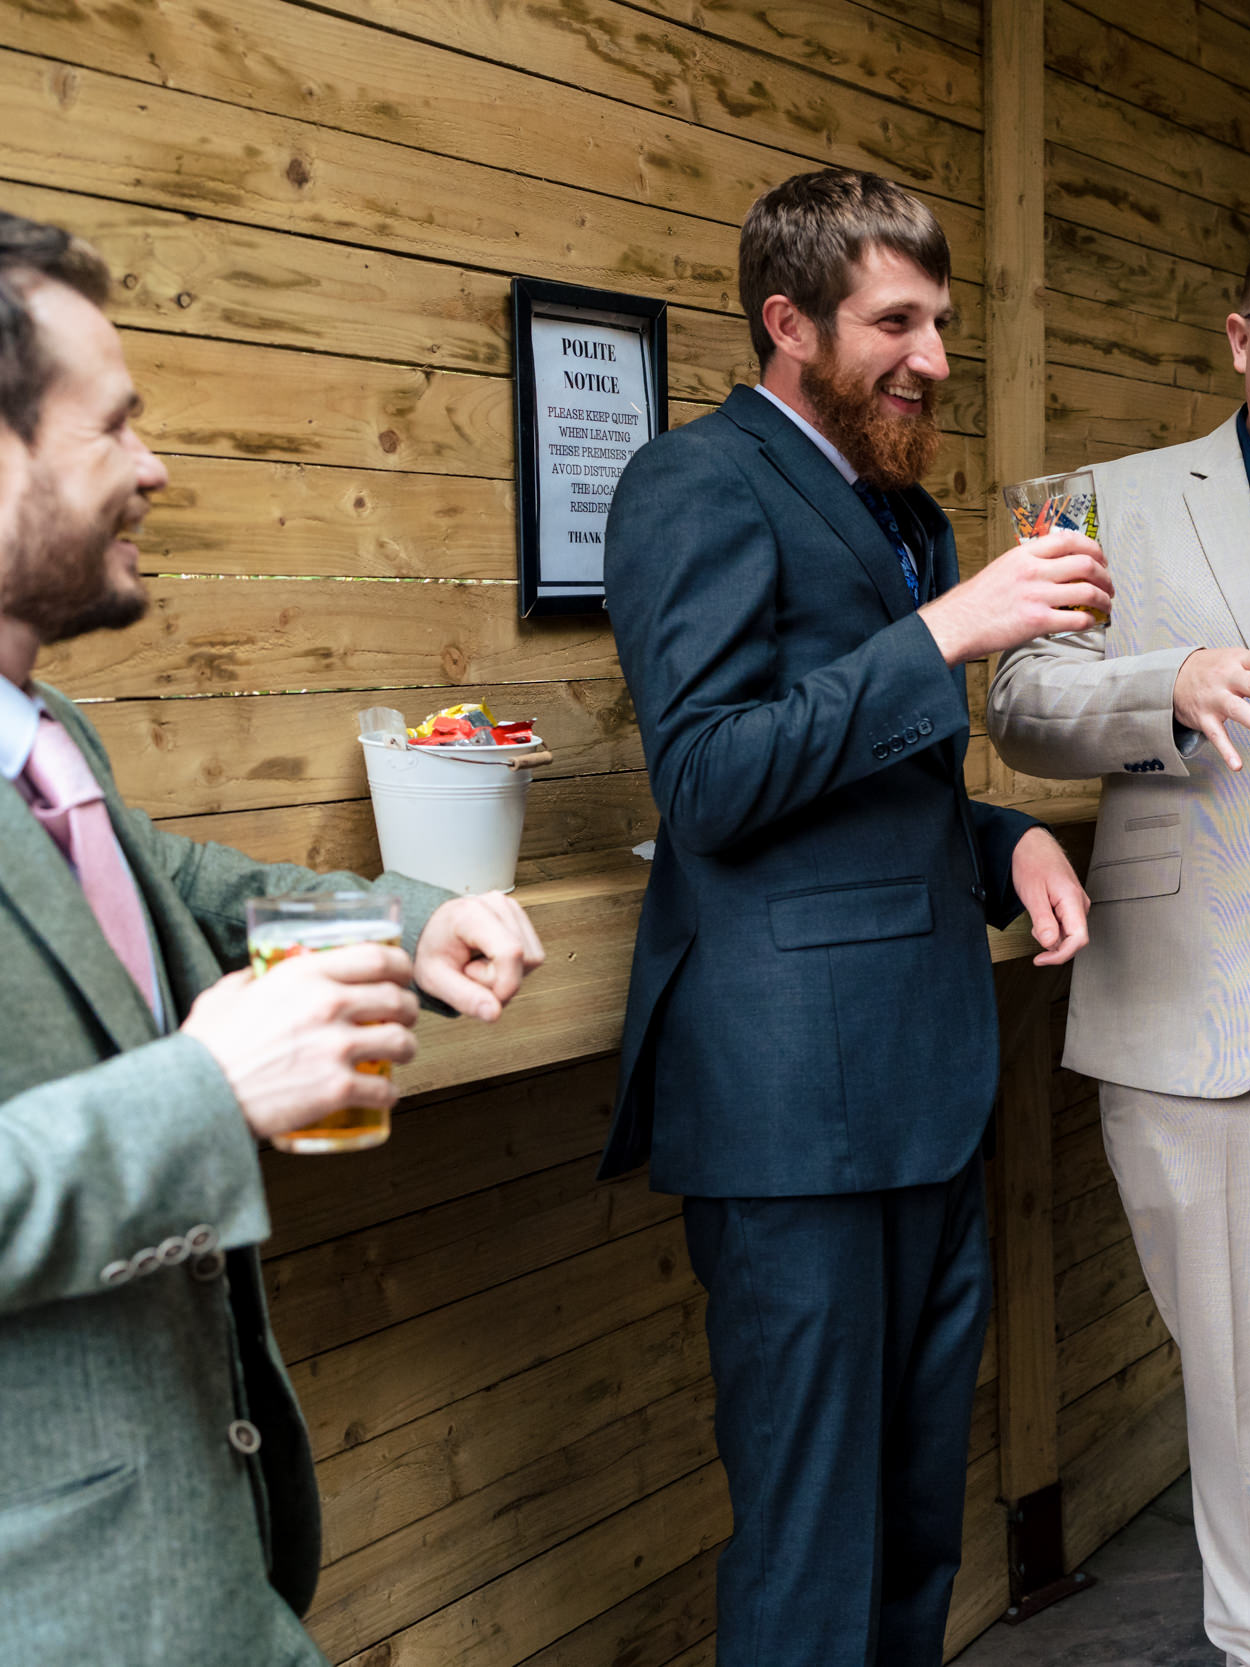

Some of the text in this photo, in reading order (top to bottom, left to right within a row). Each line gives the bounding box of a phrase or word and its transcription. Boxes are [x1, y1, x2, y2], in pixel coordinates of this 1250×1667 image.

[561, 337, 616, 362] POLITE
[563, 370, 620, 394] NOTICE
[547, 406, 638, 426] PLEASE KEEP QUIET
[558, 426, 631, 443] WHEN LEAVING
[548, 443, 580, 457] THESE
[581, 446, 627, 460] PREMISES
[551, 463, 624, 478] AVOID DISTURB
[571, 482, 616, 495] THE LOCA
[570, 501, 611, 514] RESIDEN
[567, 531, 602, 544] THANK
